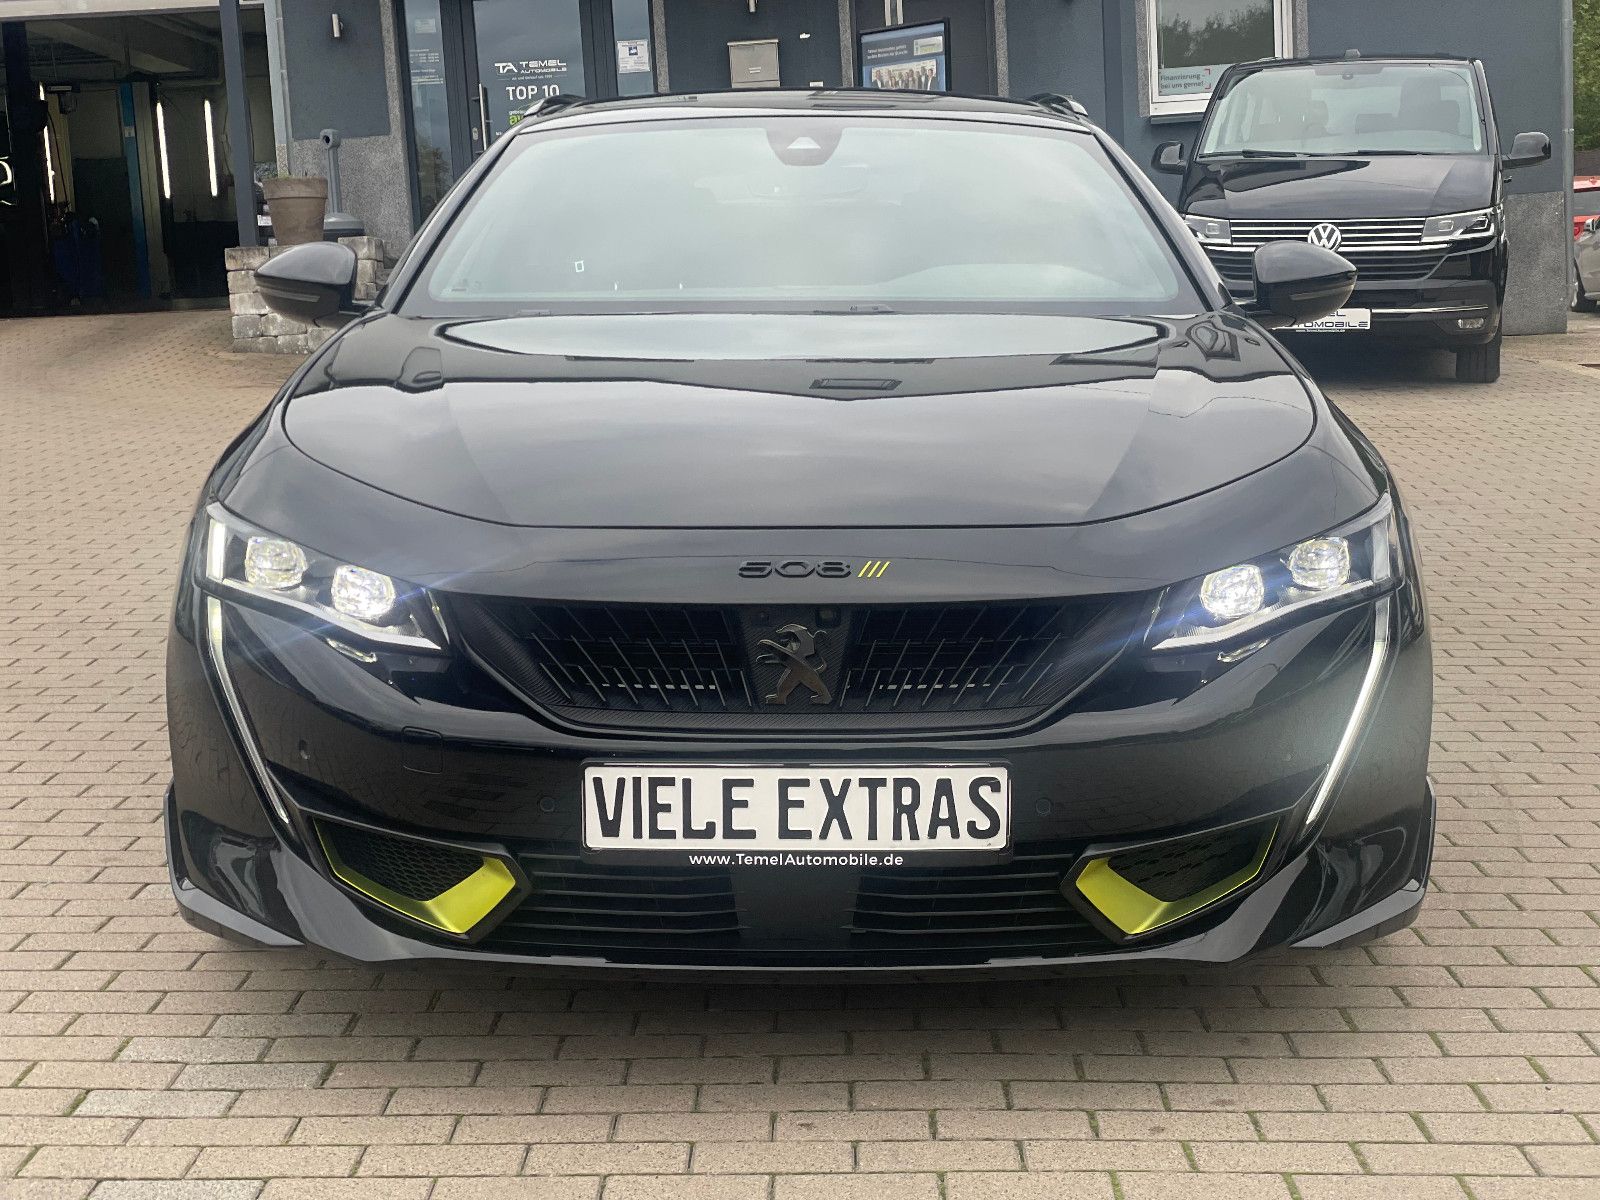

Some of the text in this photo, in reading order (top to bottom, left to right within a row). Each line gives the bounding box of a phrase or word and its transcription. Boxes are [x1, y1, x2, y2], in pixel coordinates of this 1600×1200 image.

[494, 62, 518, 74] TA
[519, 59, 567, 68] TEMEL
[505, 84, 560, 101] TOP 10
[738, 560, 852, 579] 508
[592, 776, 1002, 840] VIELE EXTRAS
[688, 853, 904, 867] www.TemelAutomobile.de
